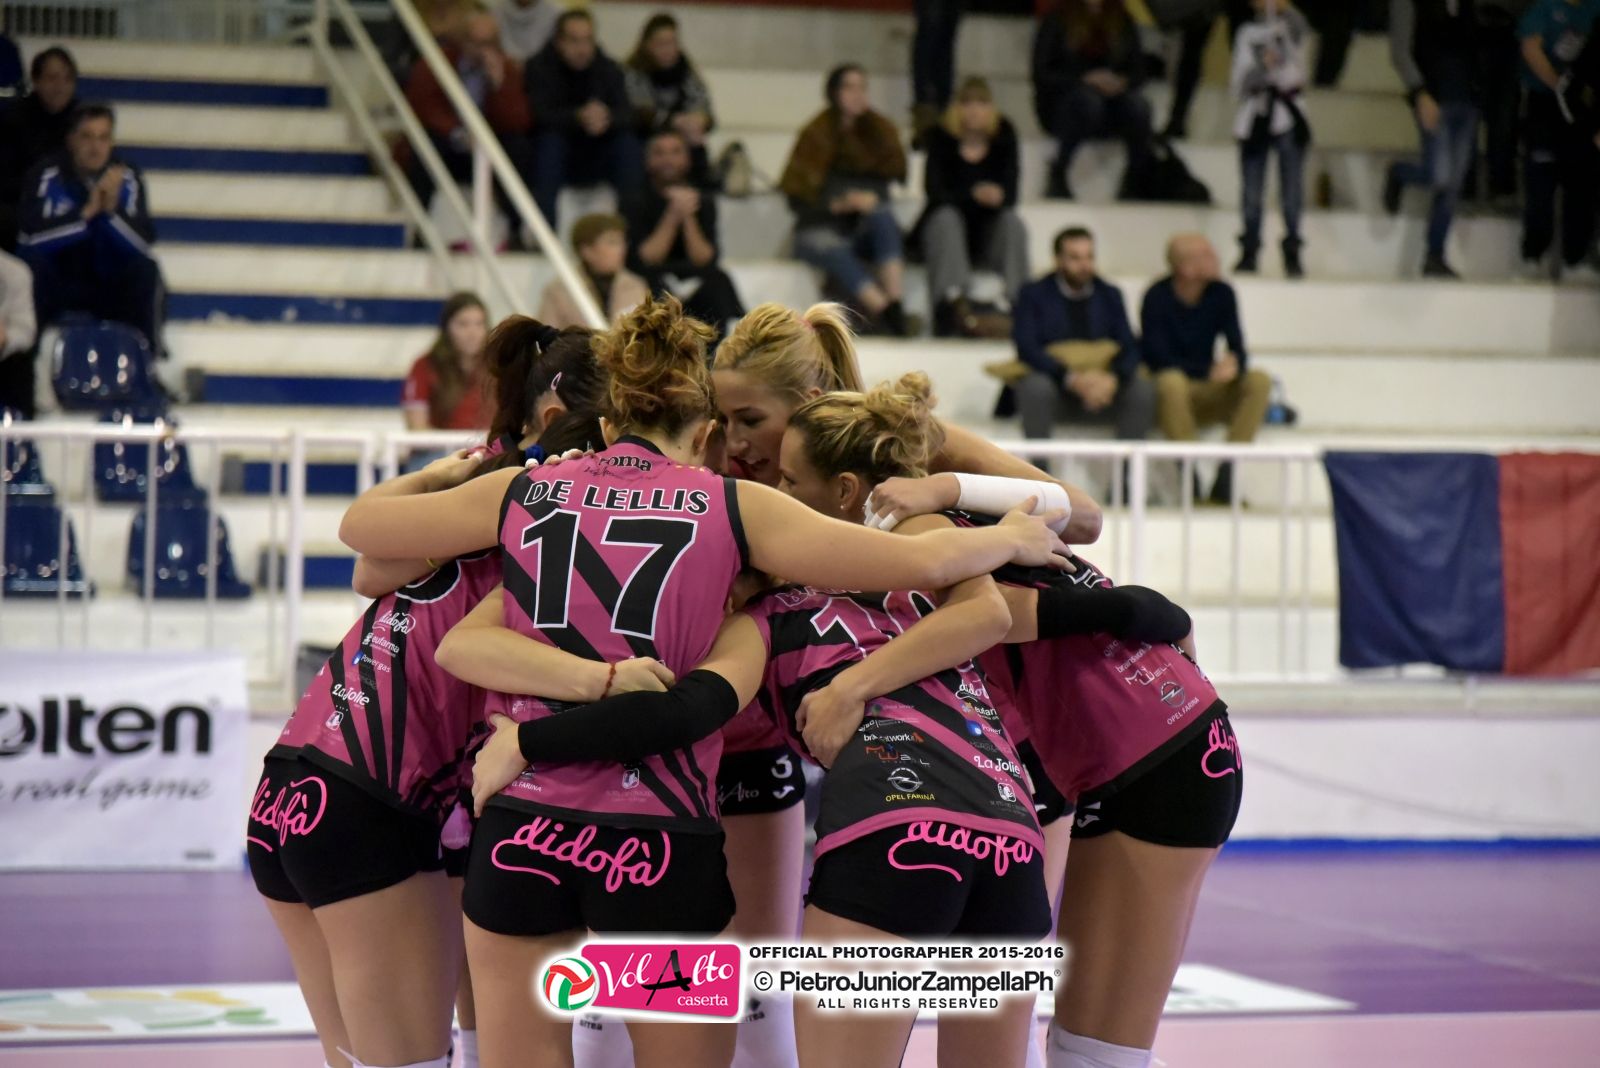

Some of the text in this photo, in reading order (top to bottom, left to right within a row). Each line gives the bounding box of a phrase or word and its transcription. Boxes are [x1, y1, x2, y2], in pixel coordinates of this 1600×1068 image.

[523, 480, 710, 515] DE LELLIS
[521, 507, 699, 640] 17
[0, 695, 212, 757] olten
[994, 758, 1021, 776] Jolie
[885, 793, 906, 802] OPEL
